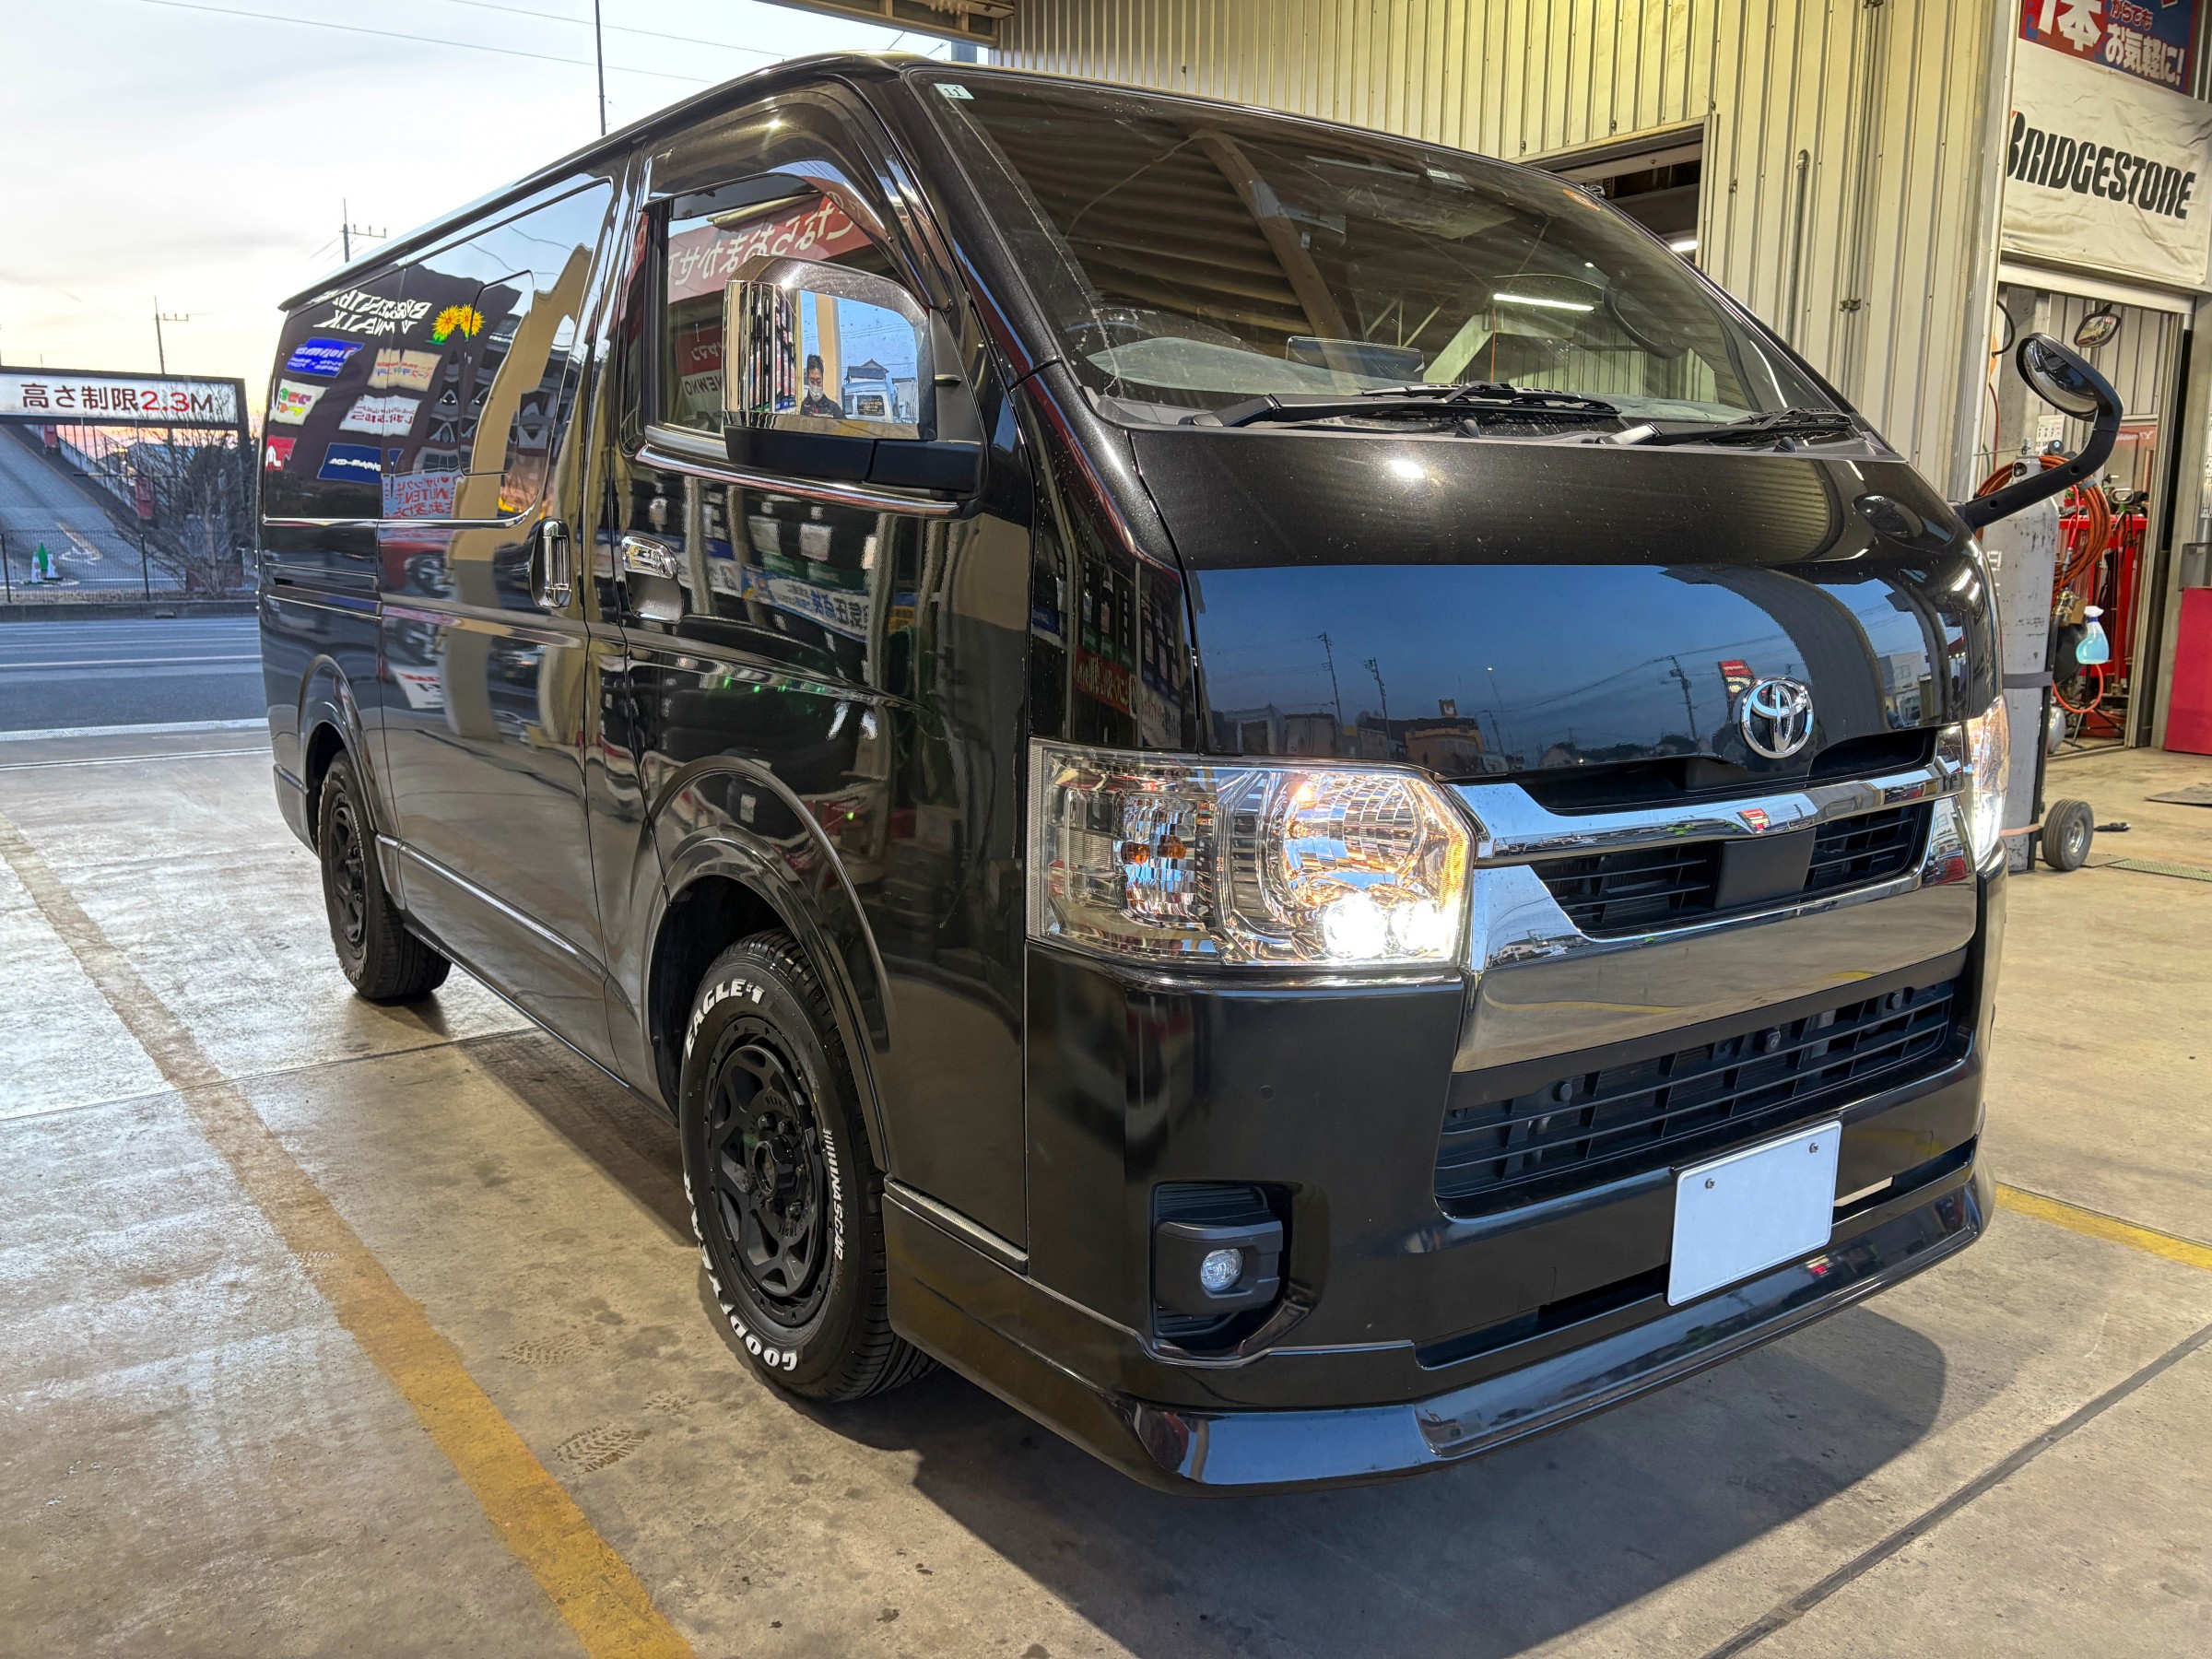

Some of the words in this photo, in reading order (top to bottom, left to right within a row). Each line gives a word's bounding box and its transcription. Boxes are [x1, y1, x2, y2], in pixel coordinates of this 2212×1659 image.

[2105, 23, 2185, 86] お気軽に!
[2006, 112, 2196, 220] BRIDGESTONE
[20, 383, 213, 413] 高さ制限2.3M
[831, 1171, 846, 1261] NASCAR
